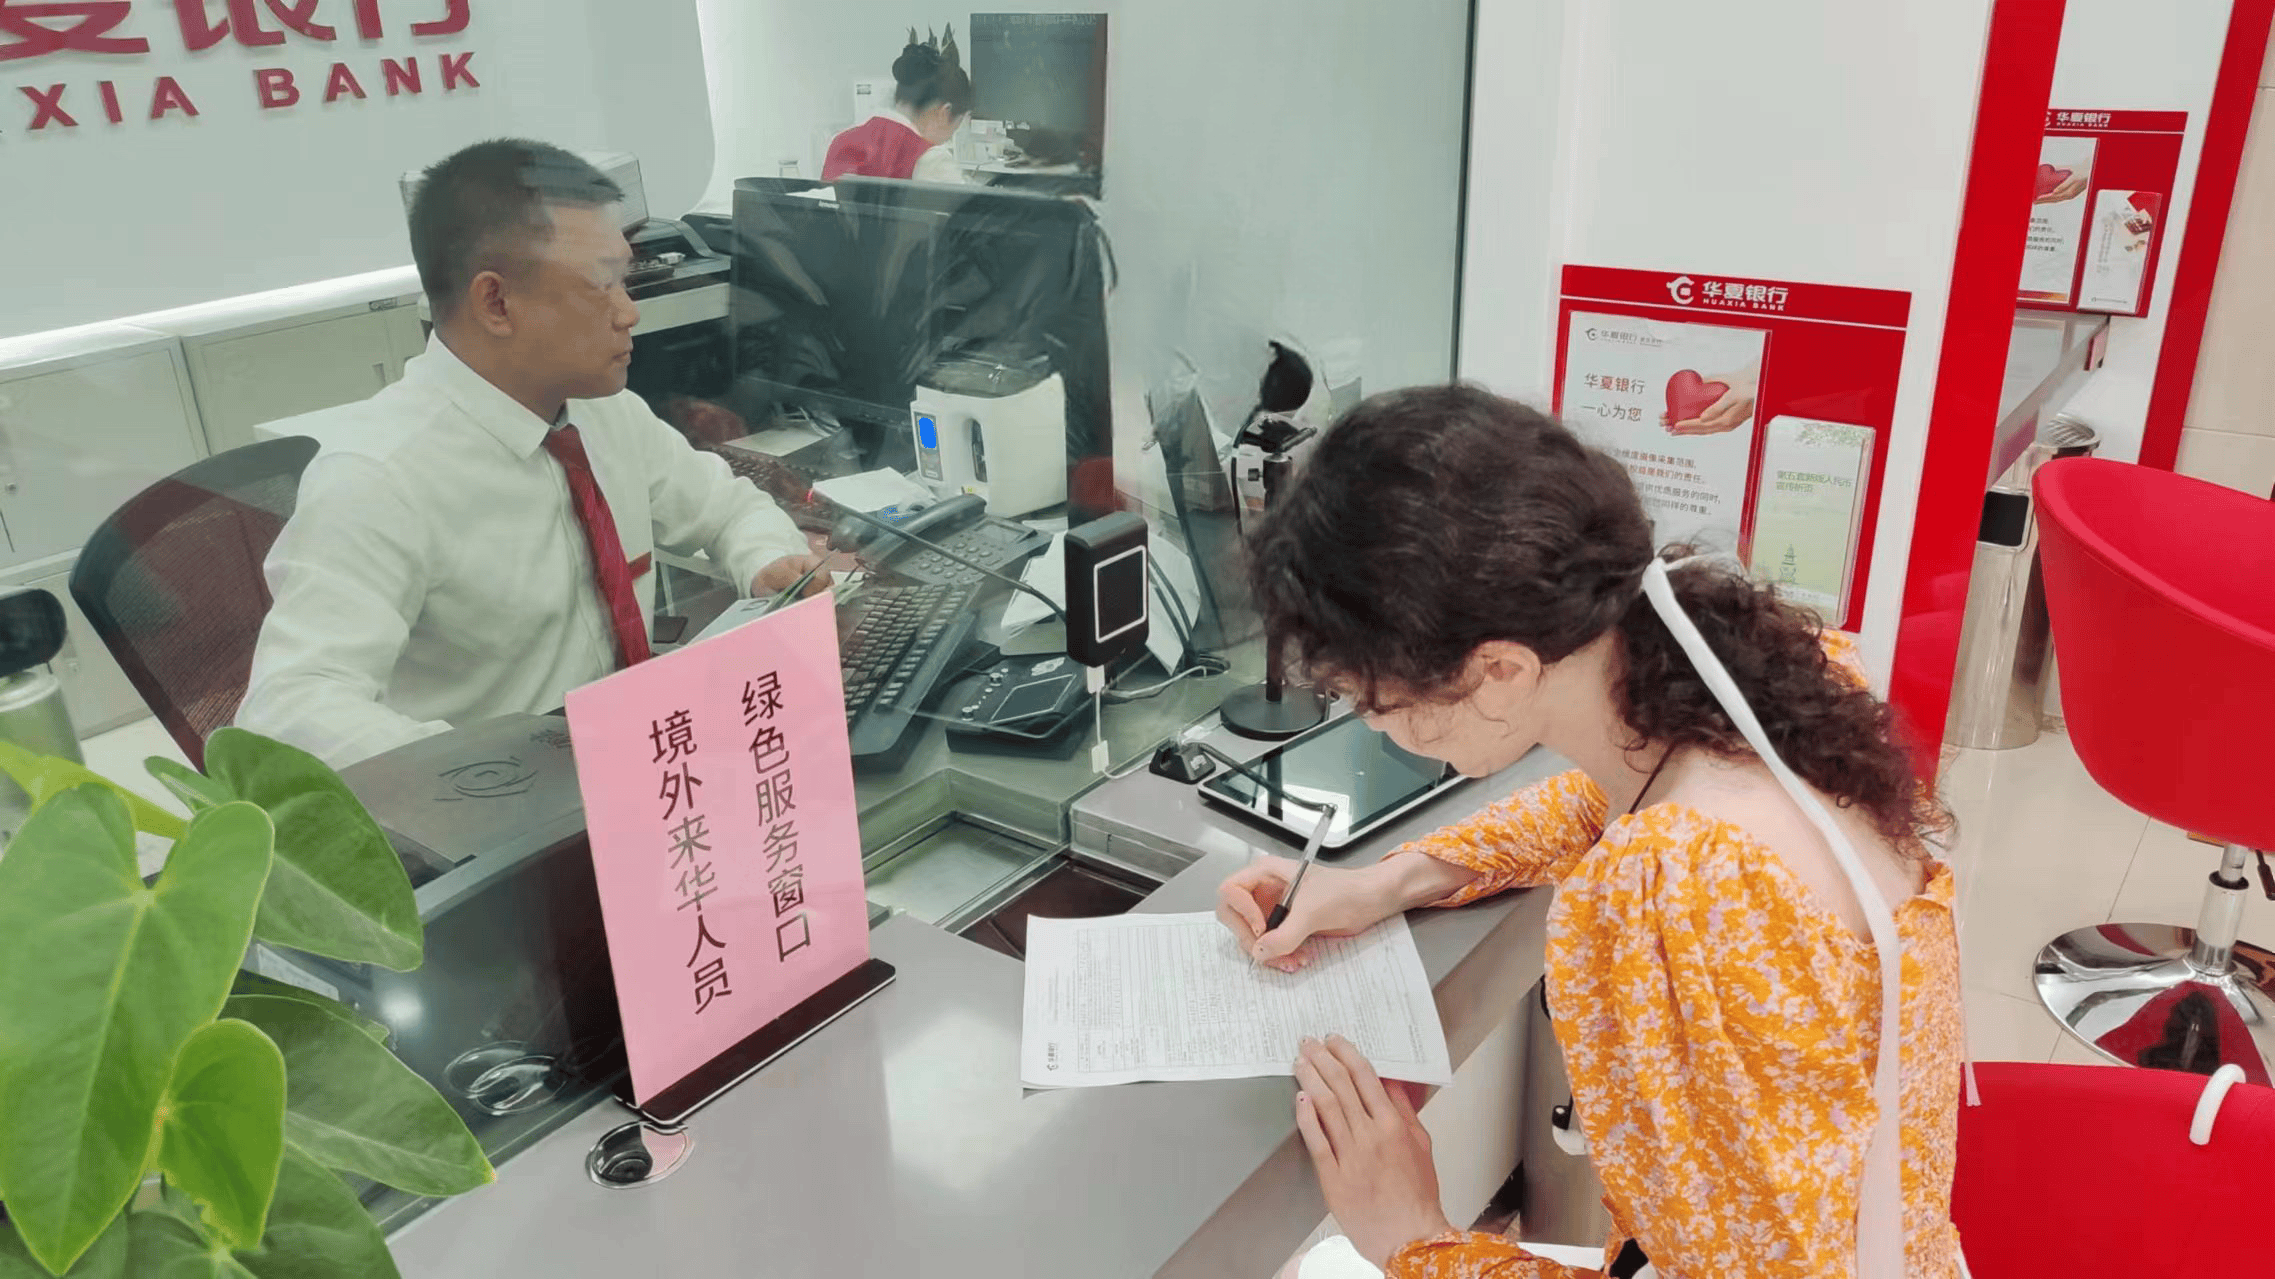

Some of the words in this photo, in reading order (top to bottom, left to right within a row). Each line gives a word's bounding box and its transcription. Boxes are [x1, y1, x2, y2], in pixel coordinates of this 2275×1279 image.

[3, 76, 200, 132] XIA
[253, 51, 480, 109] BANK
[2056, 112, 2112, 124] 华夏银行
[1702, 281, 1789, 304] 华夏银行
[1702, 298, 1747, 308] HUAXIA
[1752, 302, 1785, 312] BANK
[1584, 372, 1646, 395] 华夏银行
[1582, 402, 1643, 422] 一心为您
[741, 670, 811, 963] 绿色服务窗口
[648, 708, 732, 1015] 境外来华人员
